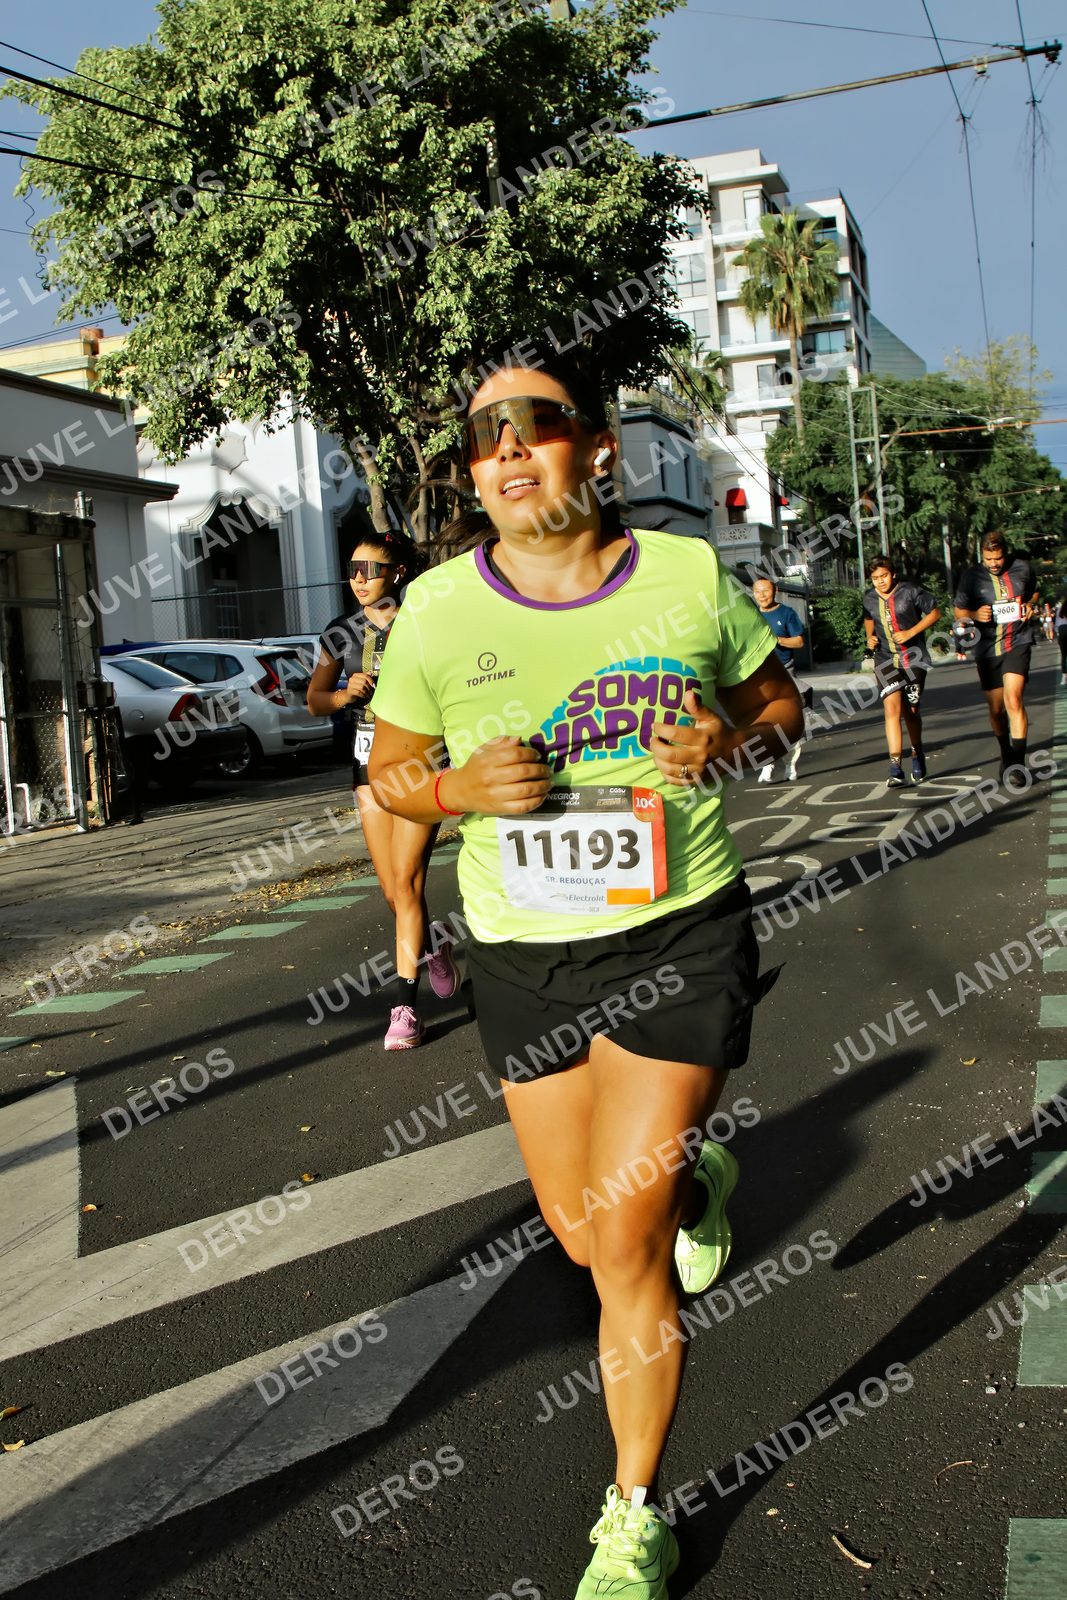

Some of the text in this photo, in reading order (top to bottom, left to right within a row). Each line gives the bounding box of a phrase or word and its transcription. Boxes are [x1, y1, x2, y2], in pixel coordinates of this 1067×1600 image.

[996, 606, 1016, 615] 9606
[466, 668, 516, 688] TOPTIME
[529, 708, 677, 773] HAPU
[744, 775, 982, 809] SOL
[505, 828, 641, 871] 11193
[545, 875, 606, 886] SR. REBOUÇAS
